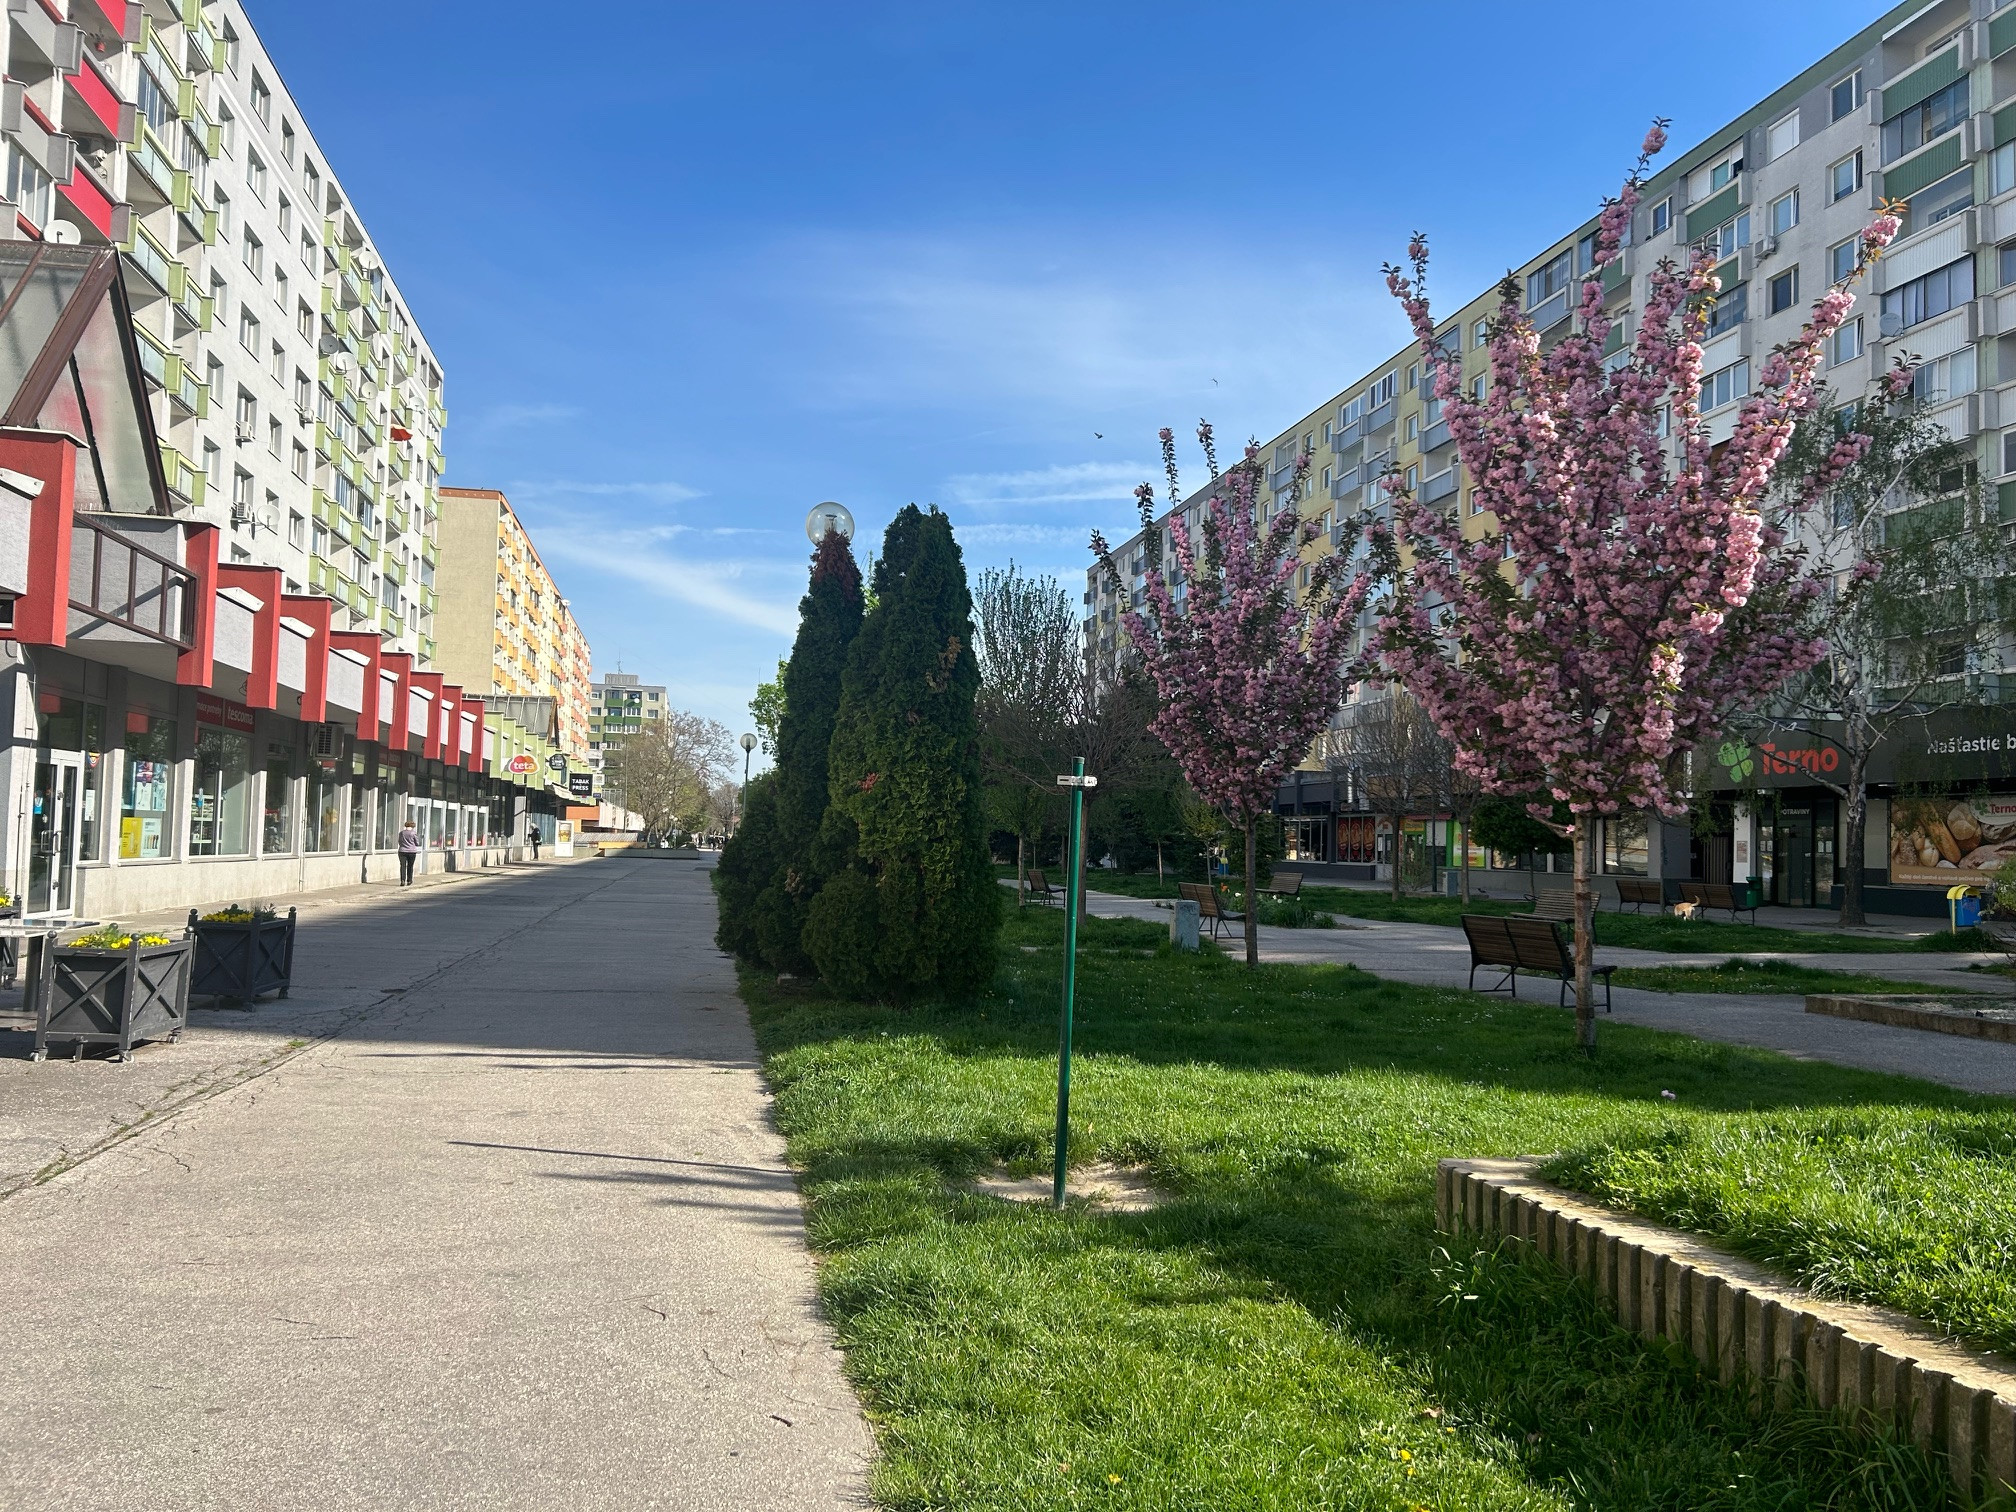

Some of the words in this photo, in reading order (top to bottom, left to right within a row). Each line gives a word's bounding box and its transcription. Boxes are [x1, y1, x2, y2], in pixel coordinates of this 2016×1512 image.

[227, 706, 253, 724] tescoma
[1927, 736, 2000, 754] Našťastie
[513, 762, 534, 770] teta
[1760, 743, 1839, 775] Terno
[1989, 803, 2016, 815] Terno
